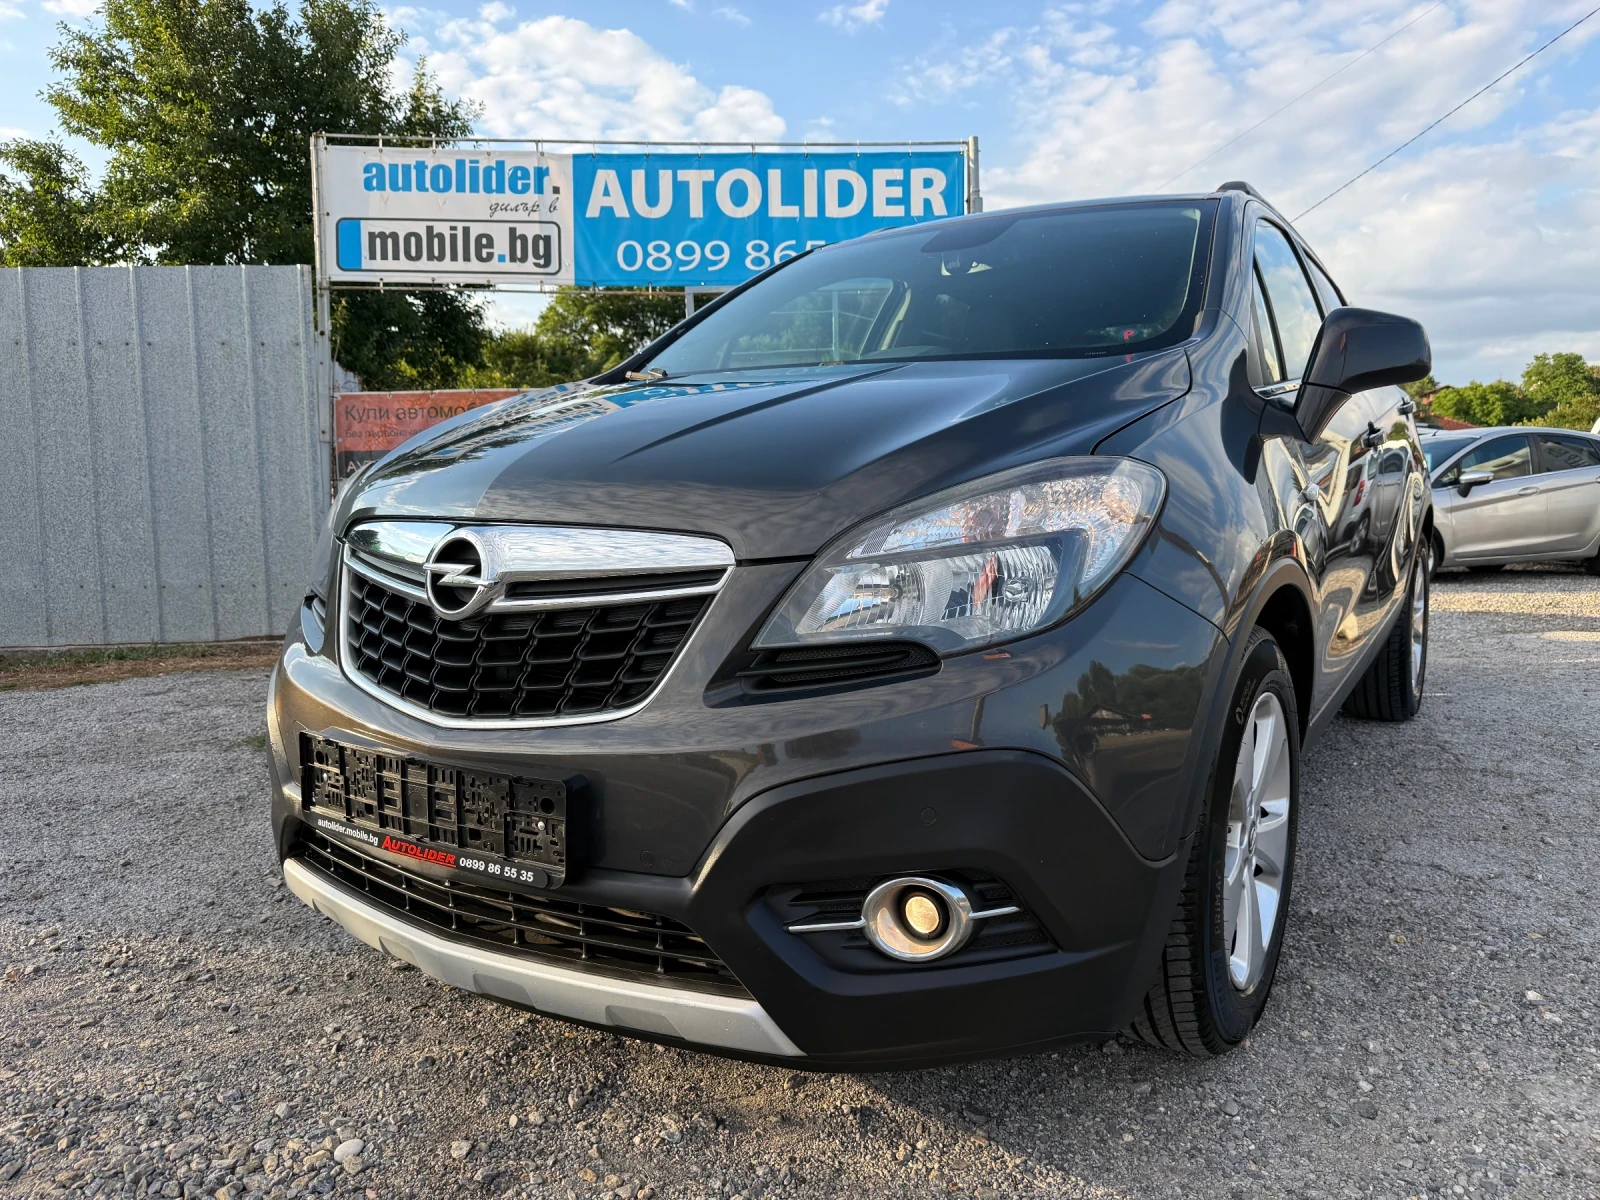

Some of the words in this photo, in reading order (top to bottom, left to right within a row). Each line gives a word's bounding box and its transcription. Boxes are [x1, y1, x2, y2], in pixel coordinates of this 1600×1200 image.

[585, 167, 948, 219] AUTOLIDER
[367, 225, 551, 268] mobile.bg
[616, 240, 730, 272] 0899
[345, 404, 390, 424] Купи
[345, 429, 363, 438] Без
[317, 818, 379, 847] autolider.mobile.bg
[459, 857, 485, 871] 0899
[487, 863, 501, 875] 86
[503, 866, 517, 879] 55
[519, 870, 534, 882] 35
